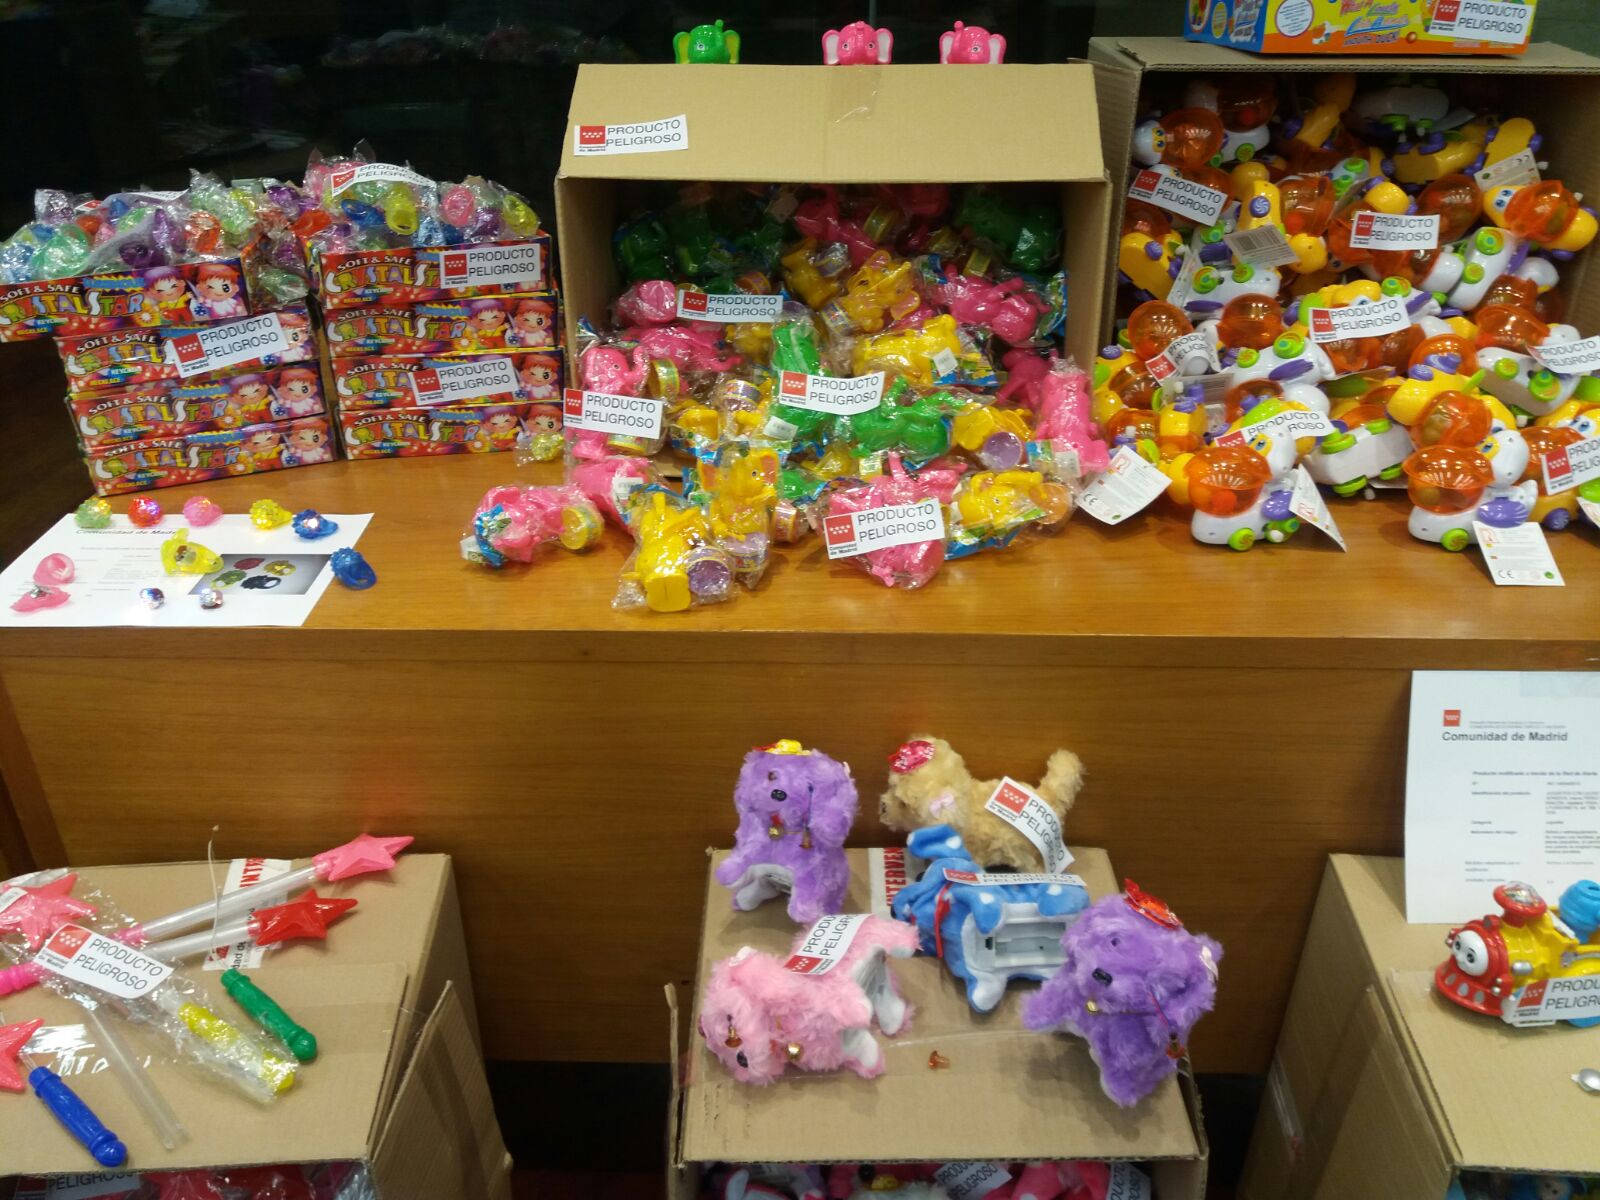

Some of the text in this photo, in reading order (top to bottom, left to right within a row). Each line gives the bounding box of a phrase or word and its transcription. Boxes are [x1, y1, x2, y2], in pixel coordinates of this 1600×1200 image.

[1463, 2, 1527, 19] PRODUCTO
[1458, 18, 1522, 34] PELIGROSO
[608, 119, 680, 135] PRODUCTO
[606, 133, 681, 146] PELIGROSO
[1162, 178, 1221, 203] PRODUCTO
[1156, 189, 1215, 216] PELIGROSO
[1374, 216, 1433, 228] PRODUCTO
[1371, 230, 1432, 241] PELIGROSO
[337, 256, 369, 272] SOFT
[371, 256, 381, 264] &
[384, 255, 413, 265] SAFE
[469, 248, 534, 263] PRODUCTO
[469, 263, 535, 278] PELIGROSO
[1, 284, 80, 302] SOFT & SAFE
[709, 296, 777, 305] PRODUCTO
[87, 290, 144, 316] STAR
[707, 307, 777, 316] PELIGROSO
[1331, 300, 1397, 319] PRODUCTO
[338, 309, 367, 322] SOFT
[382, 308, 412, 318] SAFE
[1334, 312, 1401, 331] PELIGROSO
[200, 317, 273, 344] PRODUCTO
[415, 316, 468, 341] STAR
[77, 335, 109, 353] SOFT
[125, 333, 157, 344] SAFE
[206, 332, 279, 361] PELIGROSO
[347, 362, 375, 376] SOFT
[391, 362, 419, 372] SAFE
[440, 361, 508, 379] PRODUCTO
[442, 374, 511, 393] PELIGROSO
[812, 376, 879, 391] PRODUCTO
[89, 398, 121, 414] SOFT
[136, 395, 167, 404] SAFE
[586, 395, 655, 413] PRODUCTO
[810, 391, 877, 405] PELIGROSO
[174, 399, 229, 423] STAR
[354, 414, 383, 426] SOFT
[385, 413, 394, 421] &
[398, 413, 426, 423] SAFE
[585, 410, 654, 428] PELIGROSO
[429, 421, 481, 442] STAR
[1247, 412, 1320, 437] PRODUCTO
[138, 441, 149, 449] &
[151, 440, 183, 449] SAFE
[1568, 440, 1600, 459] PROD
[188, 446, 242, 469] STAR
[857, 503, 934, 525] PRODUCTO
[859, 520, 936, 542] PELIGROSO
[1442, 731, 1568, 742] Comunidad de Madrid
[803, 916, 836, 953] PRODU
[820, 915, 853, 956] PELIGR
[89, 939, 163, 976] PRODUCTO
[74, 954, 148, 990] PELIGROSO
